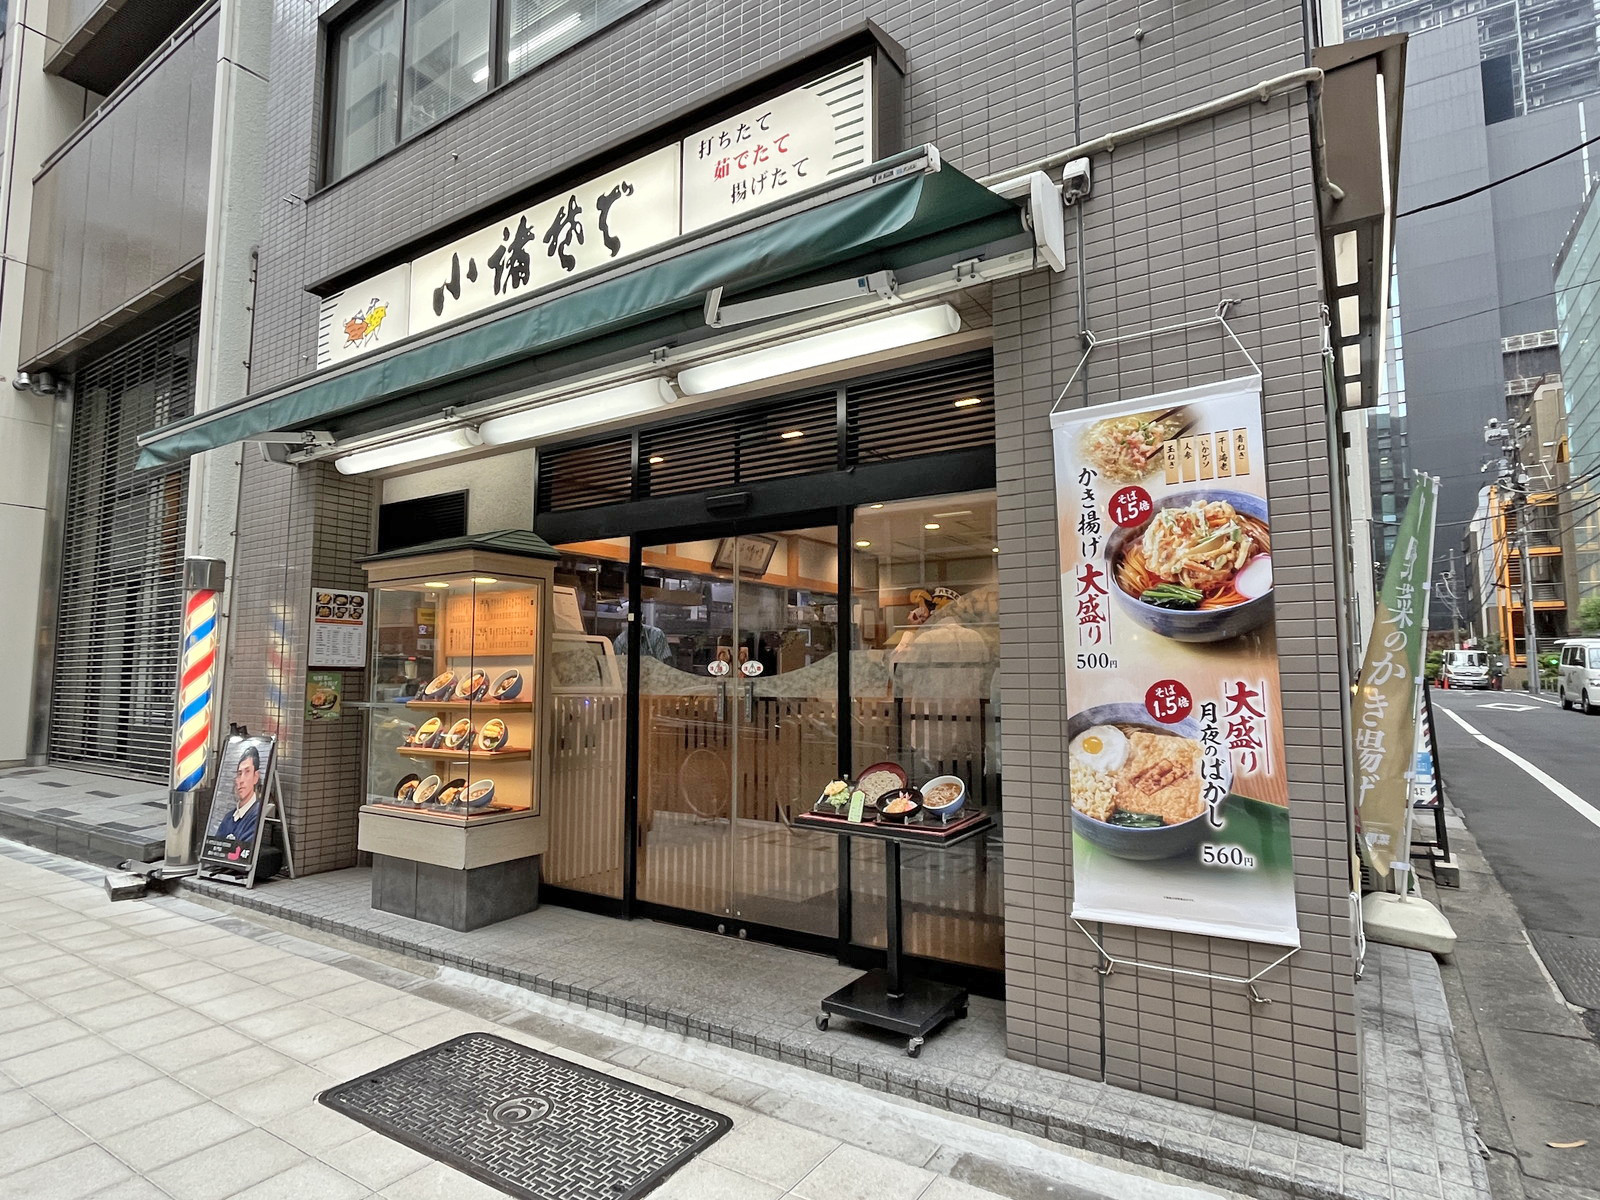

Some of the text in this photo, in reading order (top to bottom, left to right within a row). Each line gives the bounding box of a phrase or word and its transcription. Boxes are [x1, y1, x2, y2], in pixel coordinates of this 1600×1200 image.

[698, 111, 772, 160] 打ちたて
[713, 133, 790, 182] 茹でたて
[731, 157, 809, 204] 揚げたて
[1167, 444, 1175, 469] 玉ねぎ
[1184, 442, 1192, 460] 人参
[1201, 439, 1210, 468] いかゲソ
[1117, 490, 1138, 504] そば
[1078, 467, 1102, 558] かき揚げ
[1115, 501, 1150, 524] 1.5倍
[1075, 563, 1109, 646] 大盛り
[1076, 652, 1118, 669] 500円
[1155, 684, 1176, 698] そば
[1153, 696, 1190, 718] 1.5倍
[1224, 681, 1265, 773] 大盛り
[1200, 702, 1226, 828] 月夜のばかし
[1203, 845, 1254, 867] 560円
